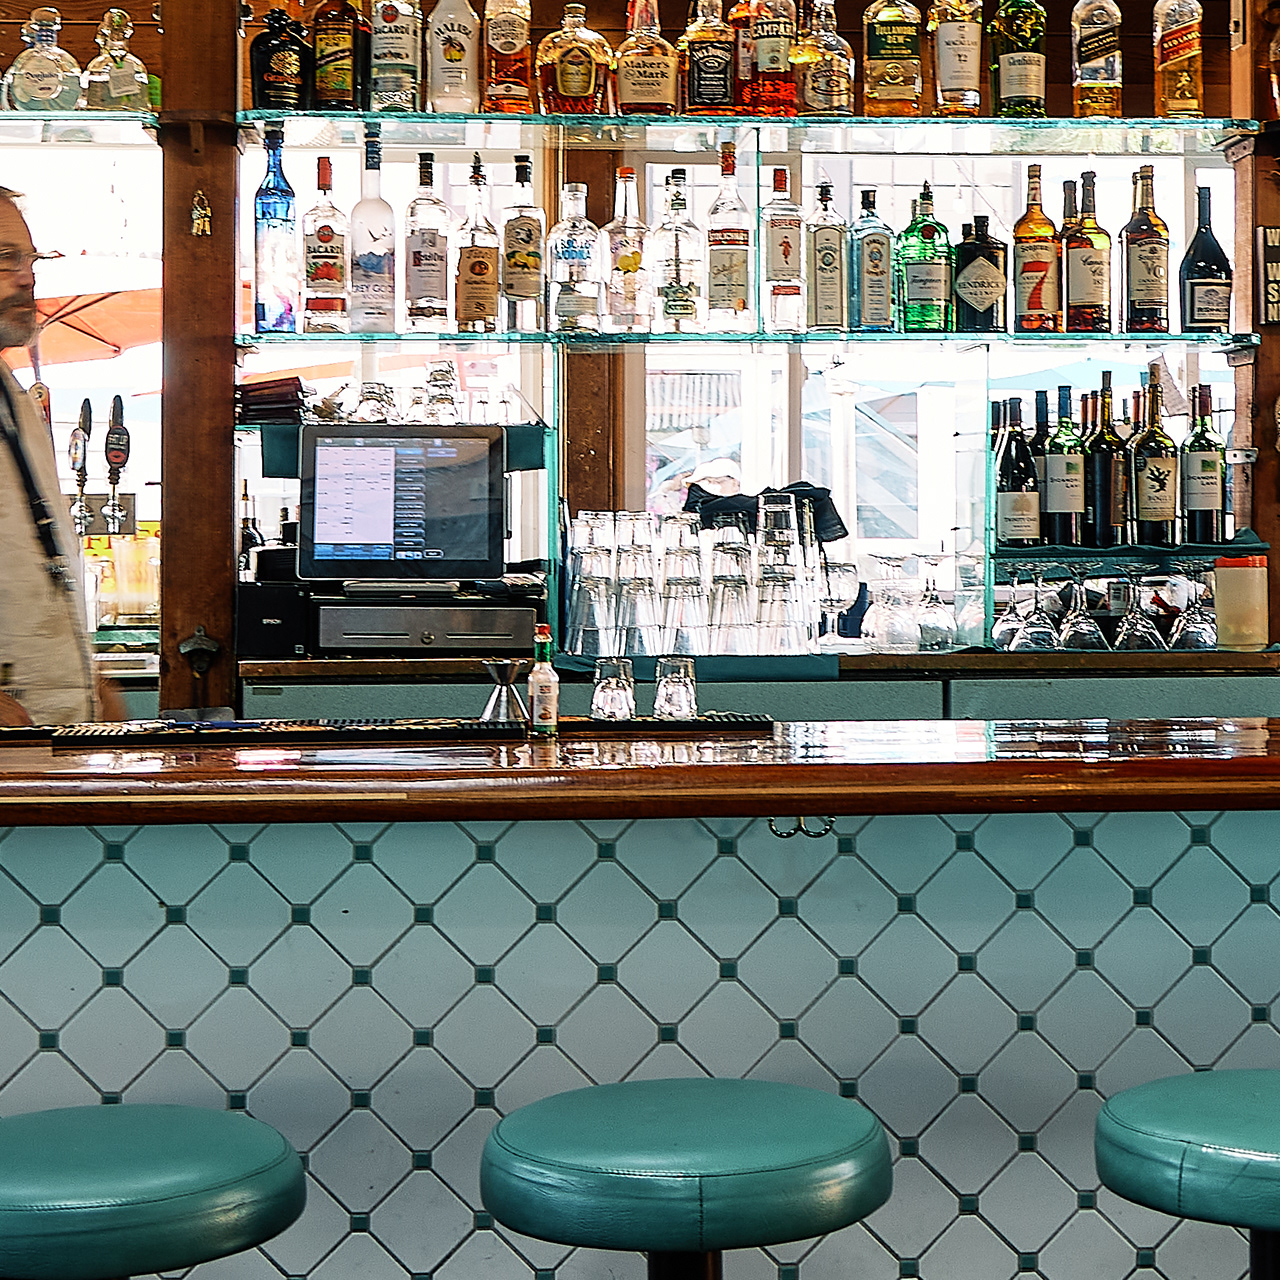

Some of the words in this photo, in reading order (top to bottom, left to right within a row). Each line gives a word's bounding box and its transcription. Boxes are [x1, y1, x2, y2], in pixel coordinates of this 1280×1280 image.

[1162, 38, 1178, 49] RED
[1177, 30, 1201, 43] LABEL
[623, 60, 670, 69] Maker's
[639, 70, 670, 79] Mark
[1021, 261, 1052, 311] 7
